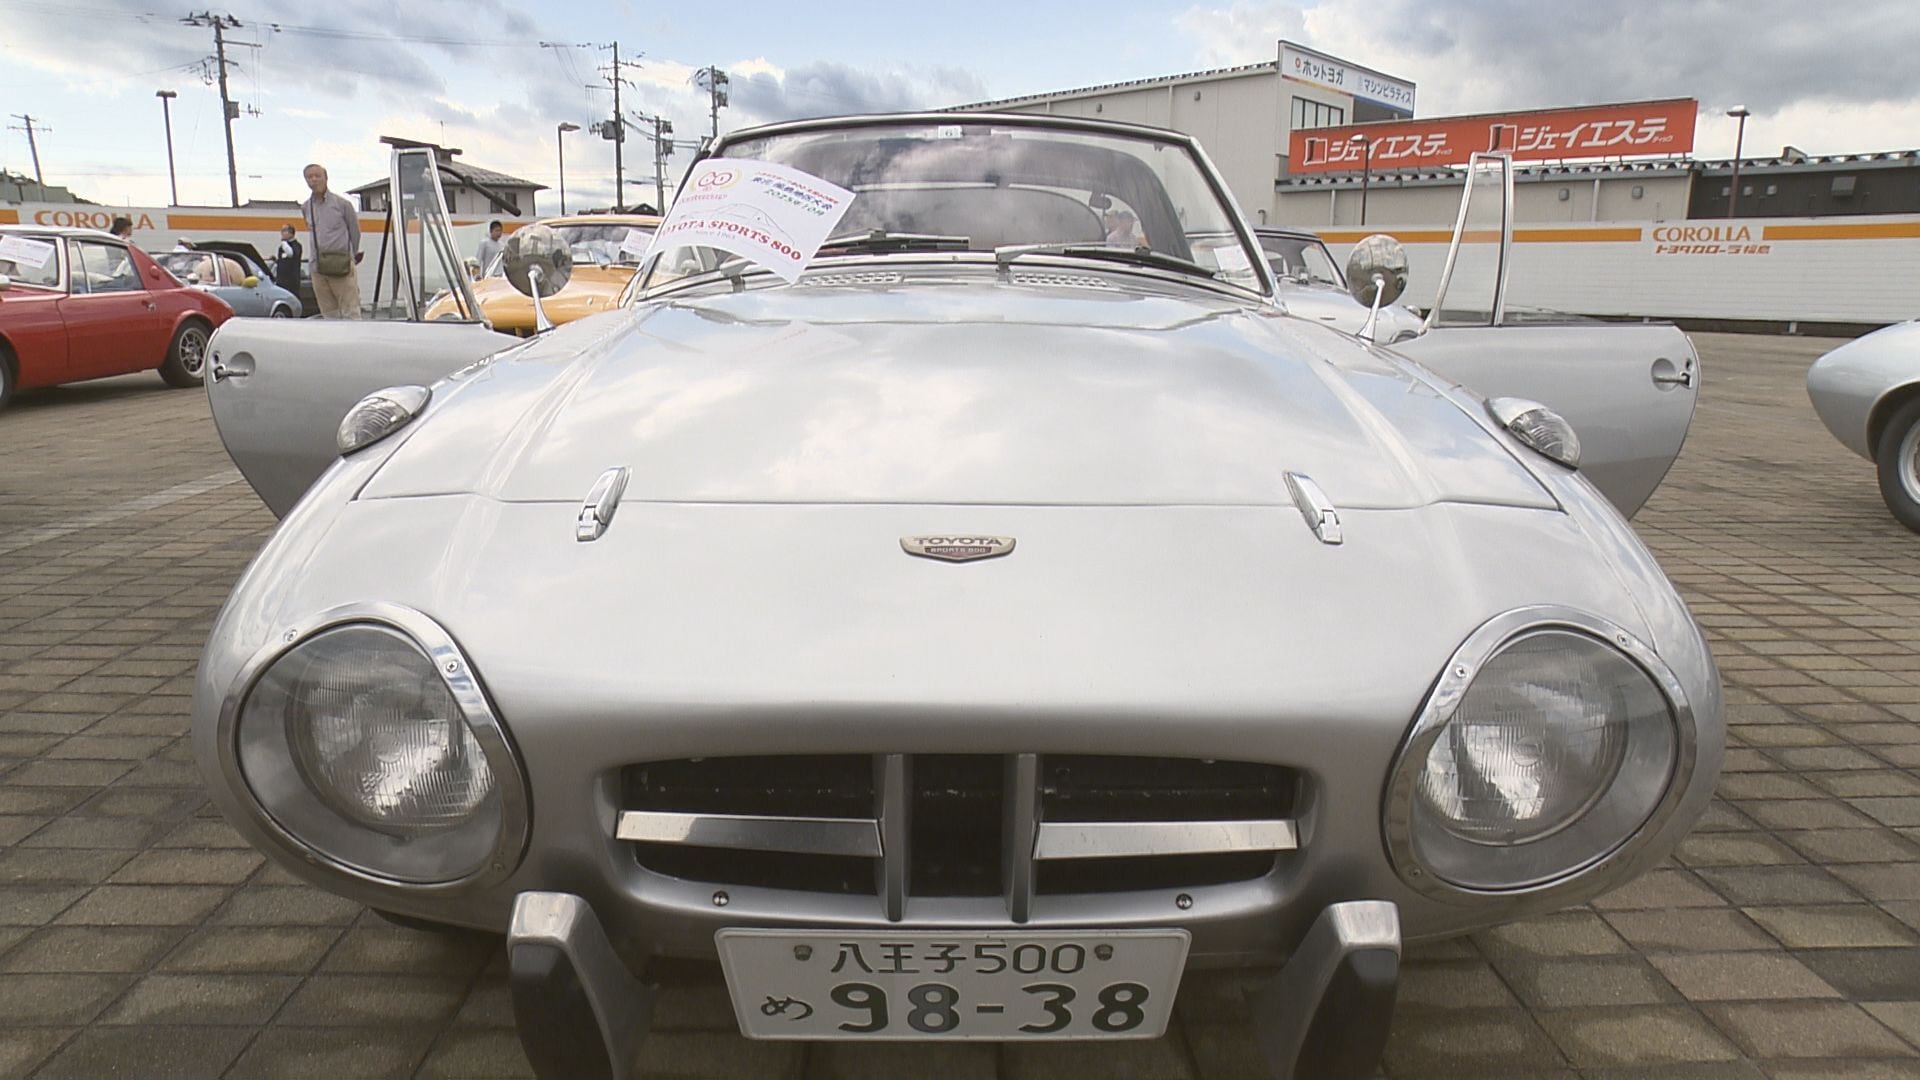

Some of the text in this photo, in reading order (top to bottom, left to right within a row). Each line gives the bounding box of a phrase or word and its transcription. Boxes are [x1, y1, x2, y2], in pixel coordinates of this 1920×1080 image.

[1302, 58, 1345, 86] ホットヨガ
[1363, 79, 1412, 104] マシンピラティス
[708, 219, 770, 245] SPORTS
[770, 239, 803, 261] 800
[1652, 225, 1751, 242] COROLLA
[913, 536, 1003, 546] TOYOTA
[830, 943, 1086, 974] 八王子500
[760, 982, 1150, 1033] め 98-38
